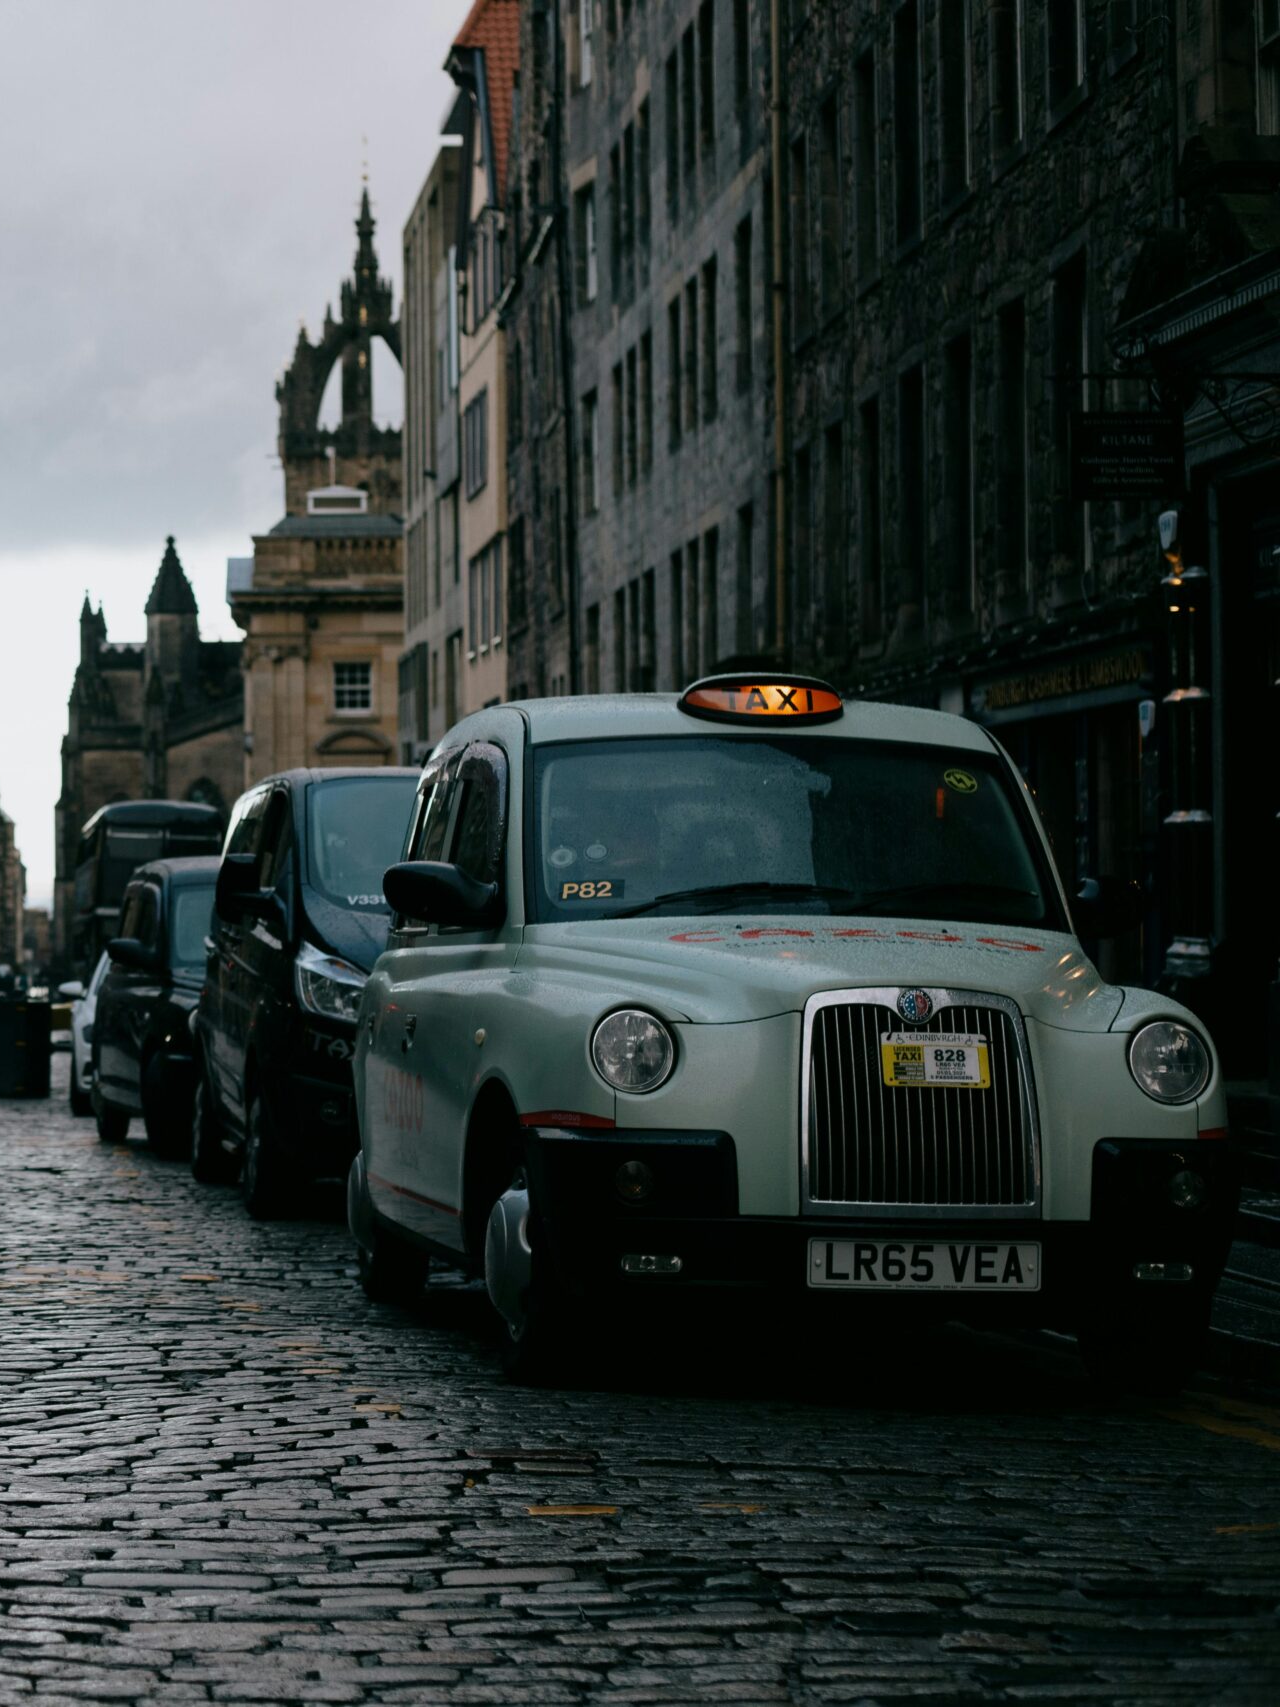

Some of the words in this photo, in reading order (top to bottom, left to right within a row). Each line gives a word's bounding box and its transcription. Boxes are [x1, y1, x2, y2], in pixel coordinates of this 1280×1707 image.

[1101, 434, 1154, 446] KILTANE
[721, 687, 814, 712] TAXI
[562, 881, 613, 899] P82
[894, 1052, 922, 1061] TAXI
[934, 1049, 966, 1062] 828
[825, 1242, 935, 1282] LR65
[948, 1244, 1024, 1284] VEA
